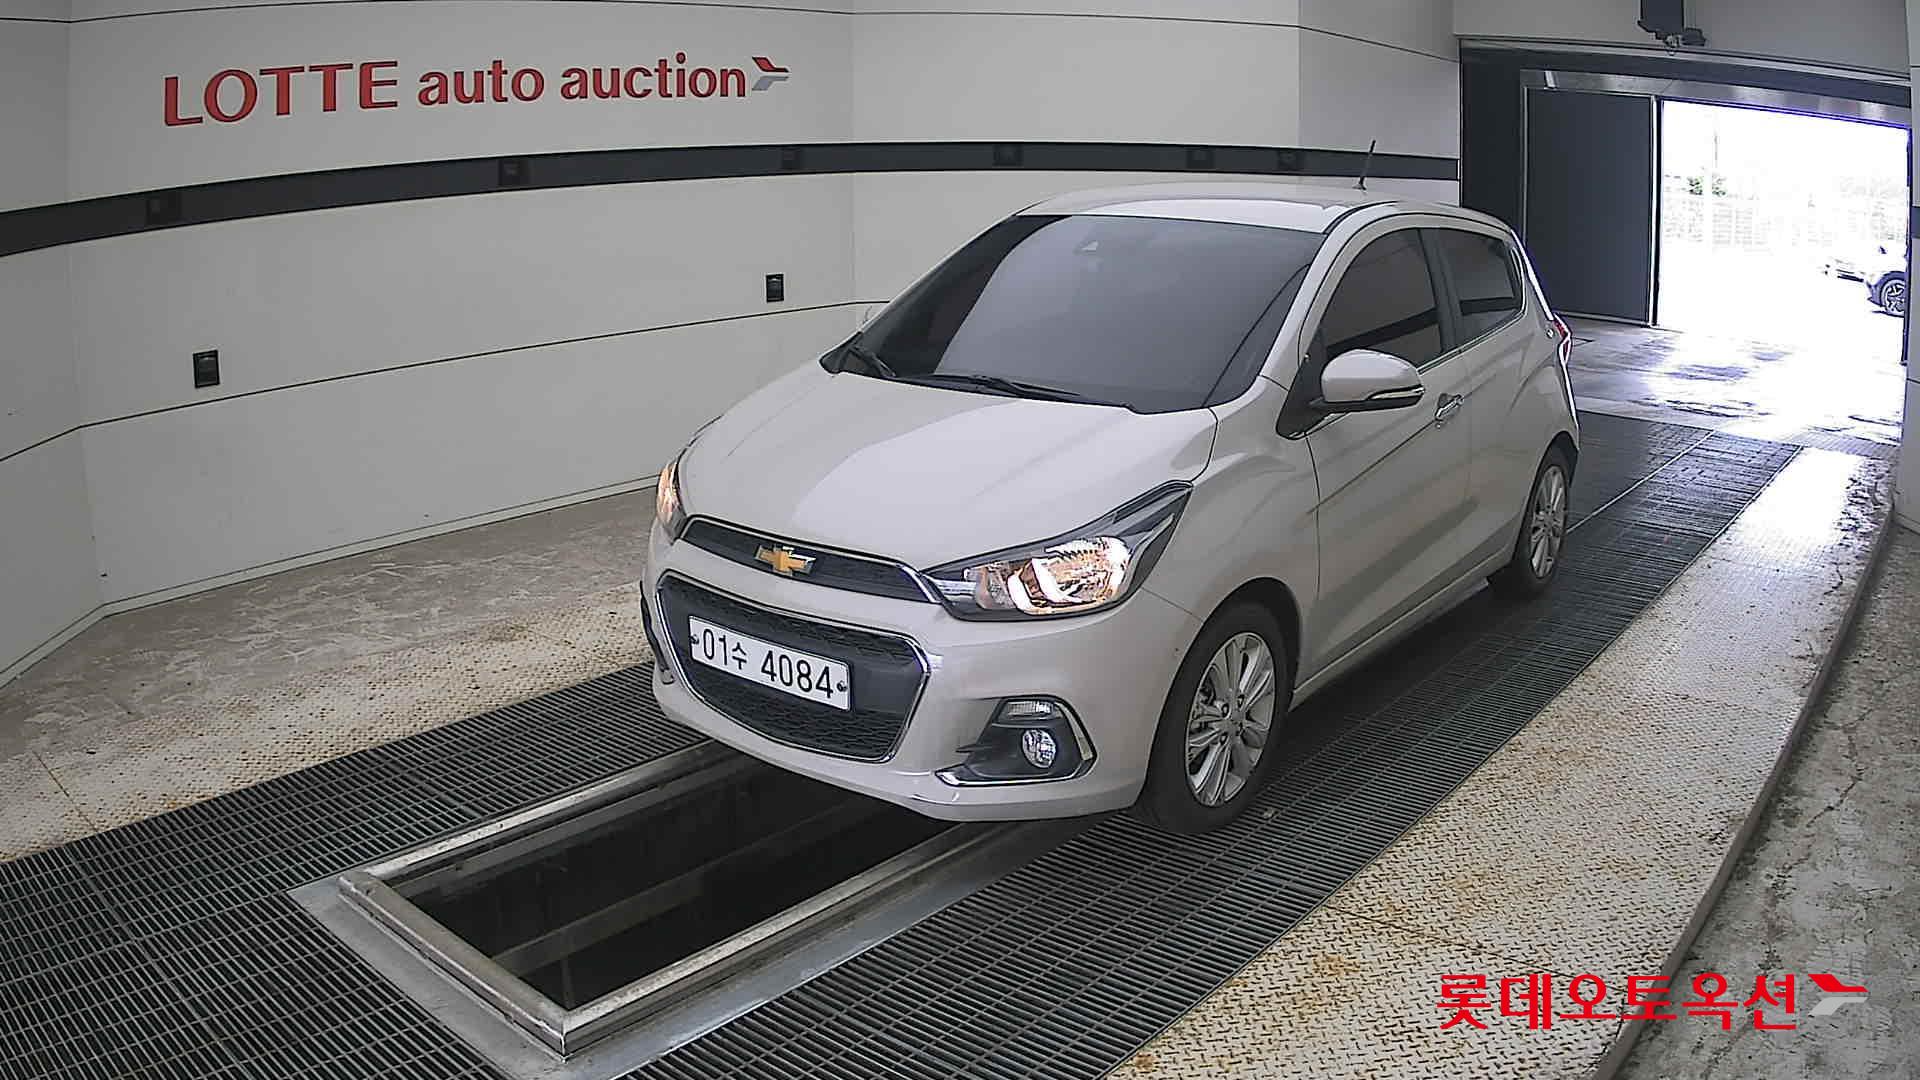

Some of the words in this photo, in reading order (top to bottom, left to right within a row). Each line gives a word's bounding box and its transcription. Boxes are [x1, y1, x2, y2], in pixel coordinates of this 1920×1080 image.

[164, 60, 398, 126] LOTTE
[417, 59, 545, 106] auto
[560, 52, 747, 99] auction
[702, 628, 748, 671] 01수
[760, 650, 834, 699] 4084
